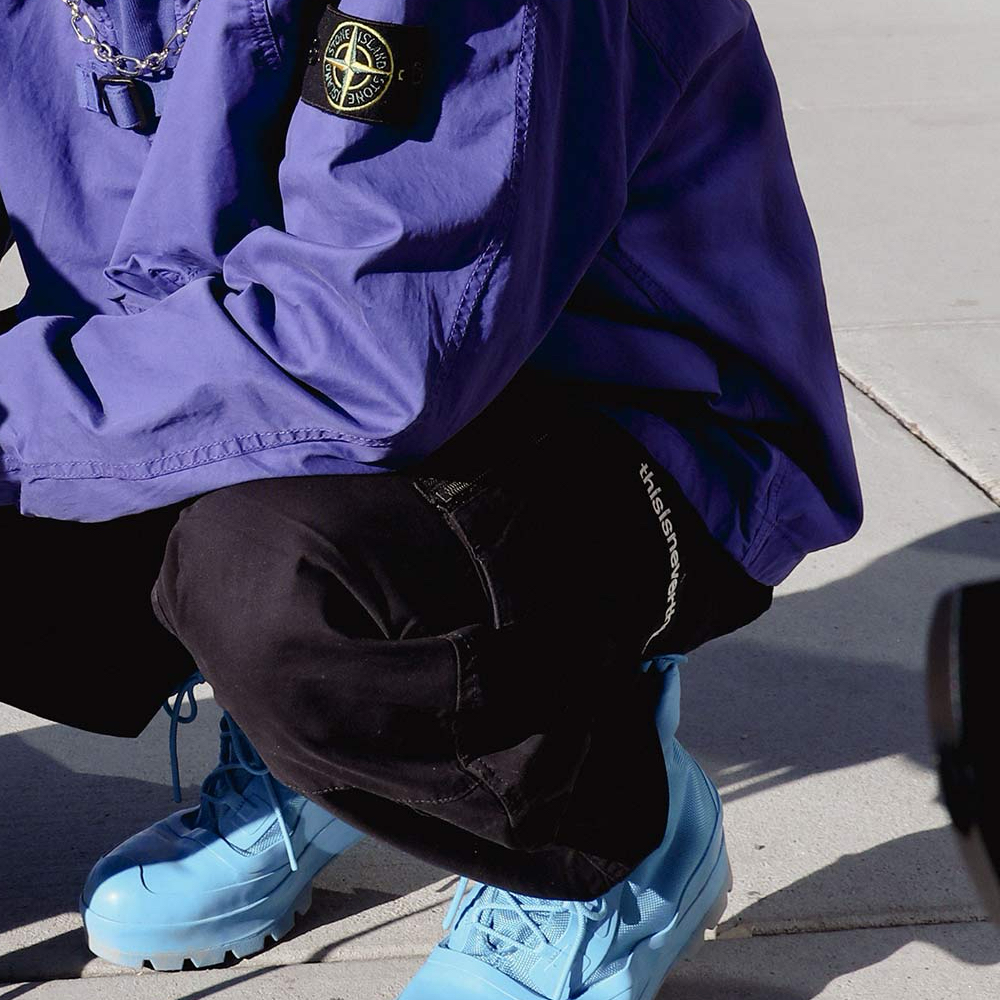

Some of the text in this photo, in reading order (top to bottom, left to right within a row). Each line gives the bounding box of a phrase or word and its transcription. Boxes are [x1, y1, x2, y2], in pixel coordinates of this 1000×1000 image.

[327, 28, 388, 70] STONE ISLAND
[324, 63, 385, 105] STONE ISLAND
